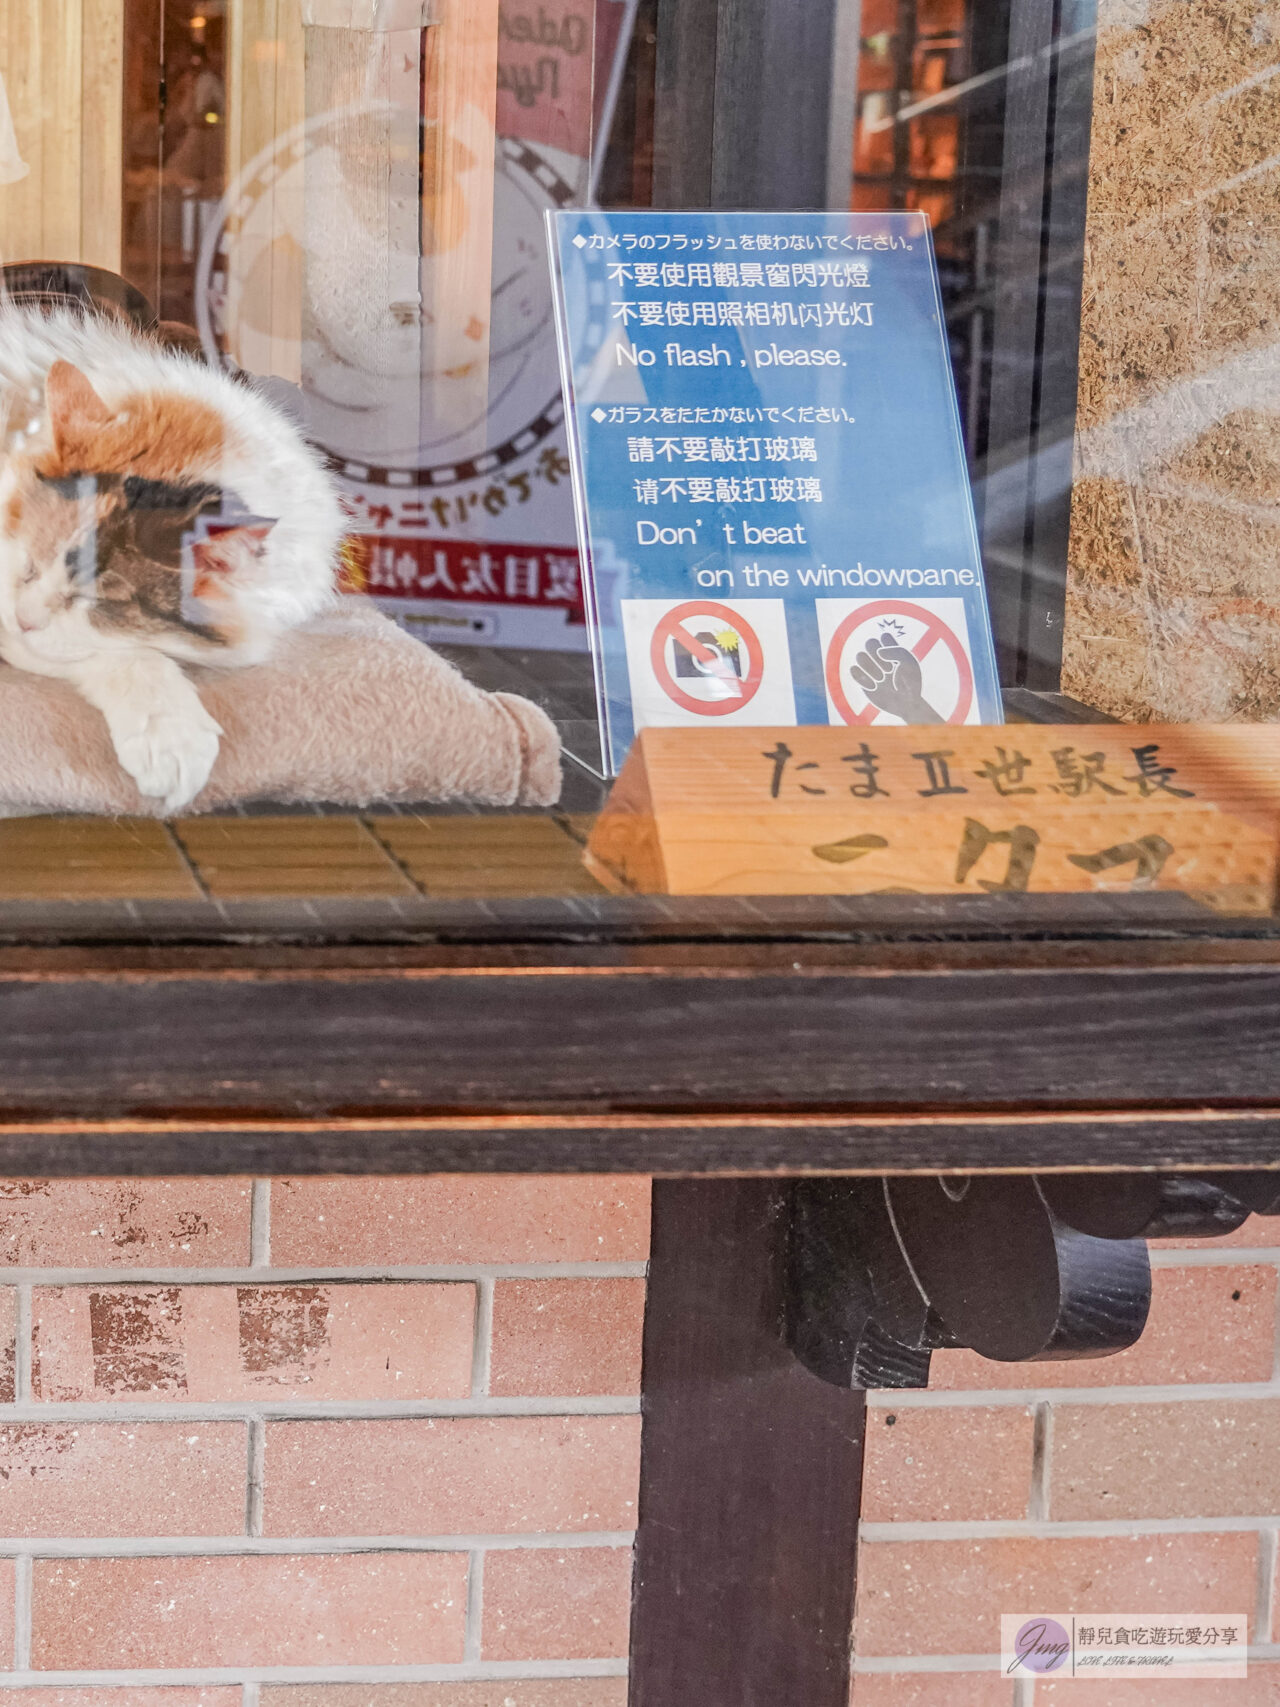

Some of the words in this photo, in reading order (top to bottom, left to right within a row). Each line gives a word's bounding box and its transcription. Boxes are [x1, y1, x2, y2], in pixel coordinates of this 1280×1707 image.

[588, 233, 914, 252] カメラのフラッシュを使わないでください。
[607, 262, 871, 288] 不要使用觀景窗閃光燈
[612, 301, 874, 328] 不要使用照相机闪光灯
[615, 343, 656, 368] No
[663, 342, 732, 367] flash
[754, 343, 848, 369] please.
[608, 406, 856, 425] ガラスをたたかないでください。
[627, 436, 818, 463] 請不要敲打玻璃
[632, 476, 824, 504] 请不要敲打玻璃
[742, 520, 808, 545] beat
[695, 567, 735, 588] on
[741, 562, 790, 588] the
[796, 561, 982, 590] windowpane.
